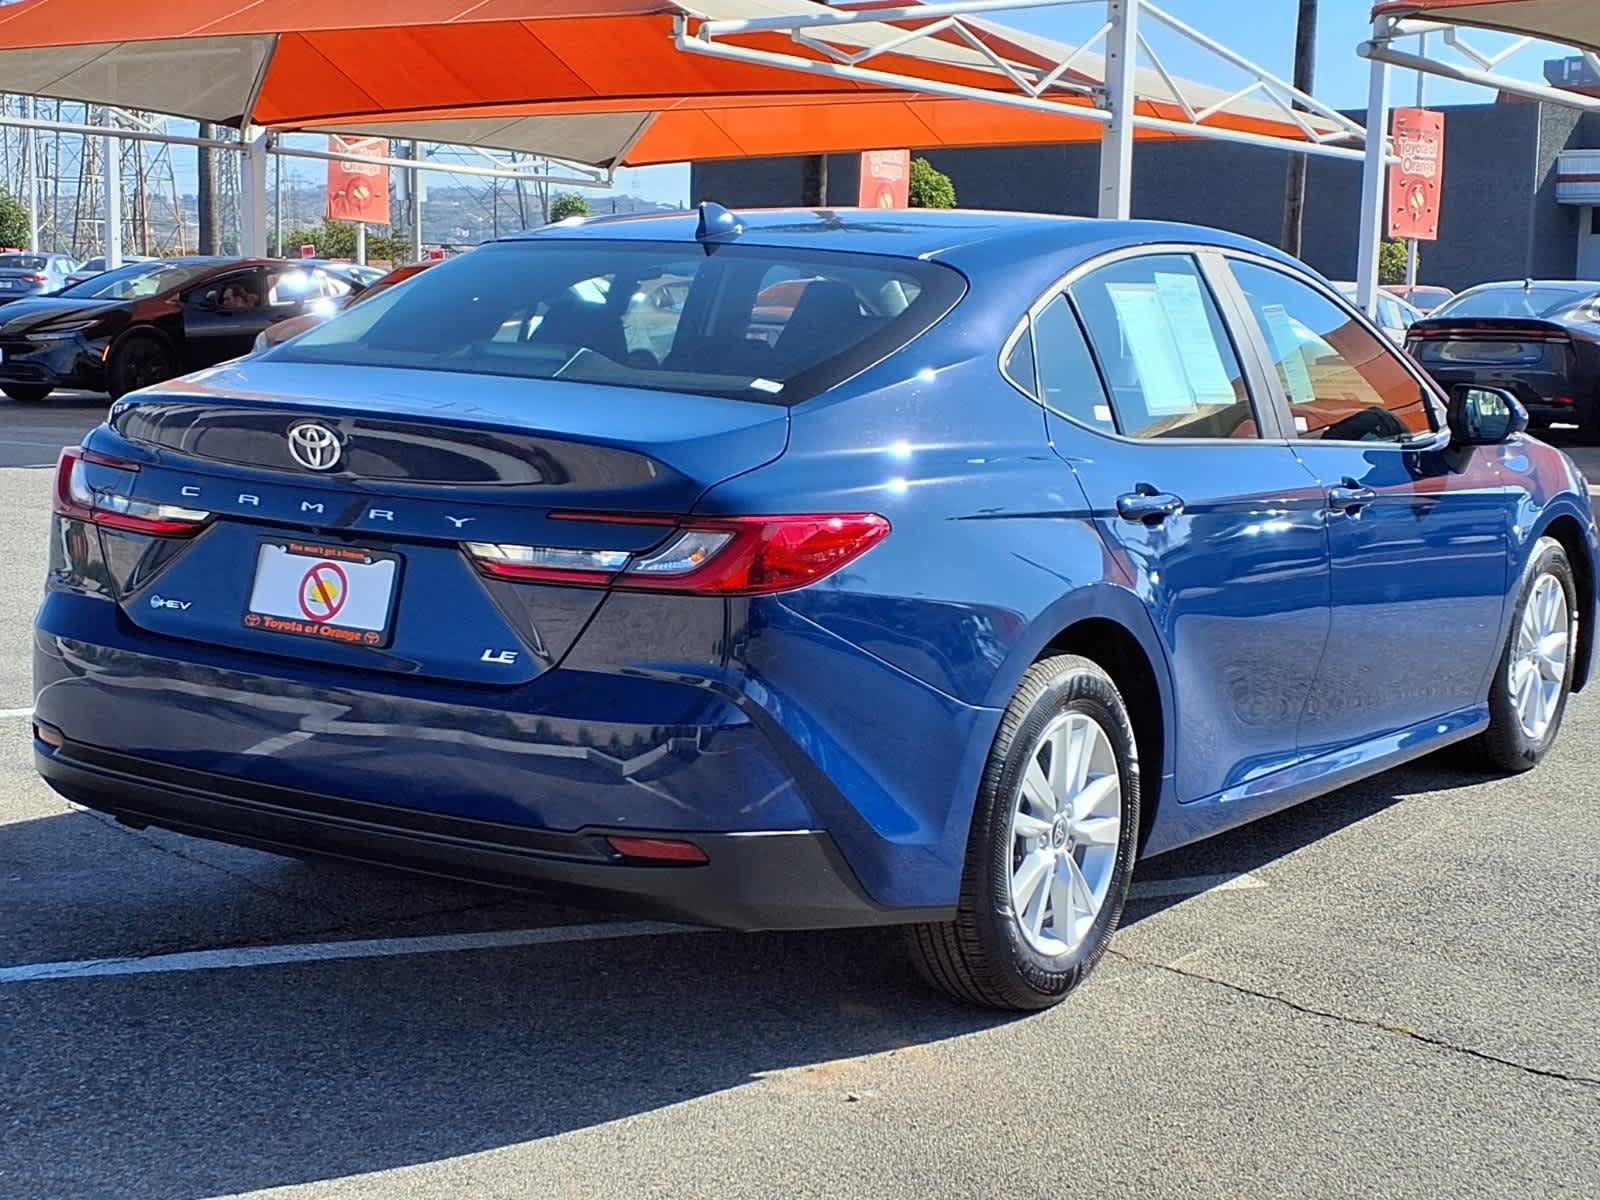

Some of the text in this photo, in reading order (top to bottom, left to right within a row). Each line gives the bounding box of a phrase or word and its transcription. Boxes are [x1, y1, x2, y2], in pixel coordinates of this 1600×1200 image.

[181, 485, 476, 528] CAMRY
[159, 599, 192, 609] HEV
[263, 616, 362, 641] Toyota of Orange
[480, 649, 519, 664] LE
